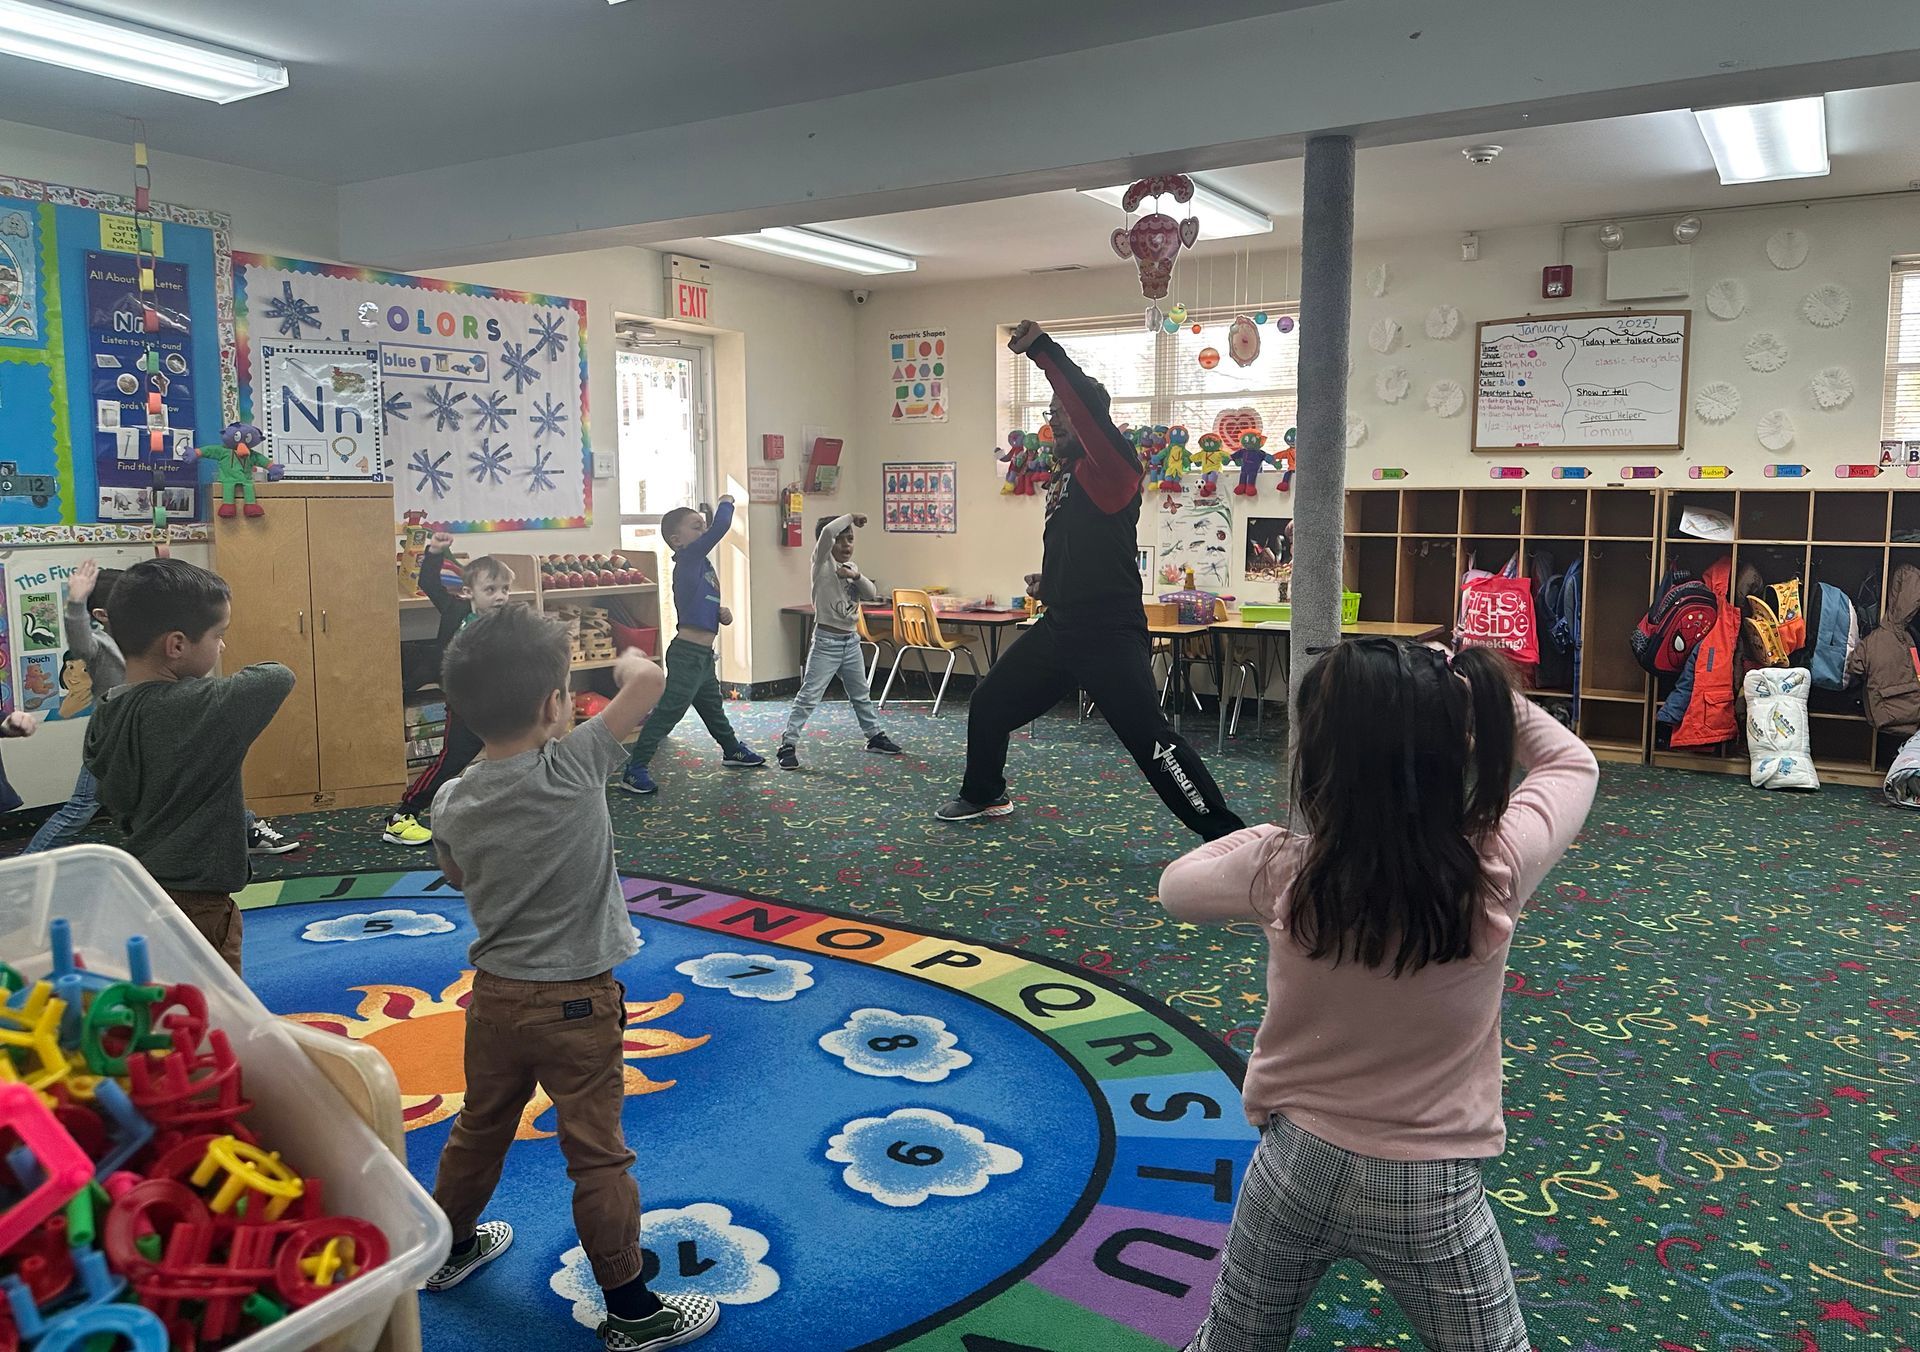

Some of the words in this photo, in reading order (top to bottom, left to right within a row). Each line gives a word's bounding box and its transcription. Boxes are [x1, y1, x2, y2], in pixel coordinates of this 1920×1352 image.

[90, 270, 103, 280] All
[105, 272, 135, 284] About
[679, 284, 708, 319] EXIT
[358, 301, 501, 342] COLORS
[1516, 324, 1568, 336] January
[1616, 318, 1658, 329] 2025!
[101, 335, 128, 345] Listen
[890, 331, 920, 340] Geometric
[922, 330, 946, 338] Shapes
[1581, 338, 1605, 347] Today
[1626, 336, 1654, 344] talked
[1656, 336, 1680, 344] about
[383, 352, 416, 368] blue
[1595, 357, 1628, 366] classic
[1577, 388, 1599, 396] Show
[1612, 388, 1628, 396] tell
[121, 401, 139, 409] ords
[282, 386, 362, 433] Nn
[1577, 399, 1607, 407] Letter
[1584, 412, 1612, 421] Special
[1617, 411, 1642, 419] Helper
[1576, 426, 1634, 442] Tommy
[288, 445, 321, 464] Nn
[1205, 451, 1216, 464] K
[1881, 451, 1892, 462] A
[1910, 451, 1919, 462] B
[117, 461, 136, 471] Find
[29, 479, 45, 492] 12
[14, 570, 47, 591] The
[27, 594, 50, 603] Smell
[27, 655, 50, 664] Touch
[320, 877, 357, 898] J
[632, 886, 707, 910] M
[363, 919, 394, 933] 5
[720, 908, 800, 936] N
[816, 929, 885, 950] O
[911, 949, 982, 970] P
[726, 965, 776, 980] 7
[1018, 982, 1097, 1018] Q
[867, 1034, 919, 1052] 8
[1086, 1031, 1173, 1067] R
[1130, 1091, 1222, 1122] S
[1137, 1159, 1233, 1203] T
[1093, 1227, 1220, 1298] U
